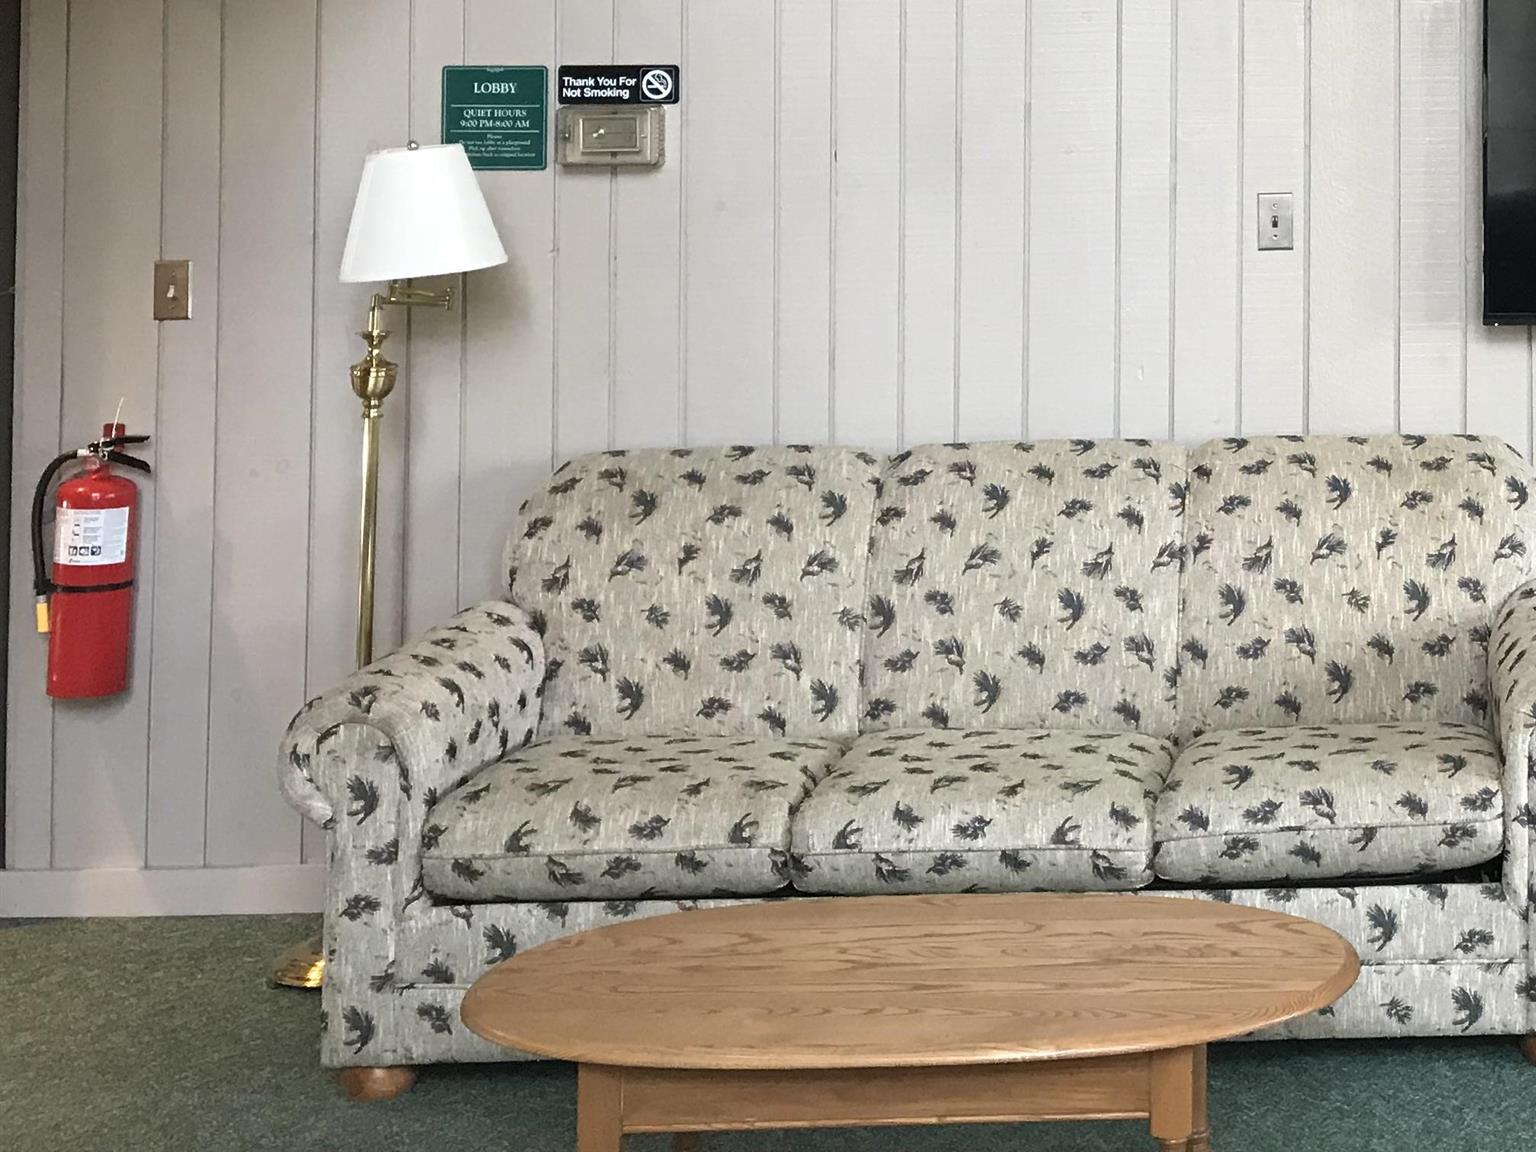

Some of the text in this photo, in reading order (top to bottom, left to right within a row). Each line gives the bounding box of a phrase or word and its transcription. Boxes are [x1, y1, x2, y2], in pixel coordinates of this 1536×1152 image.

[562, 76, 638, 87] Thank You For
[473, 81, 518, 94] LOBBY
[562, 88, 630, 100] Not Smoking
[463, 109, 527, 118] QUIET HOURS
[514, 119, 530, 128] AM
